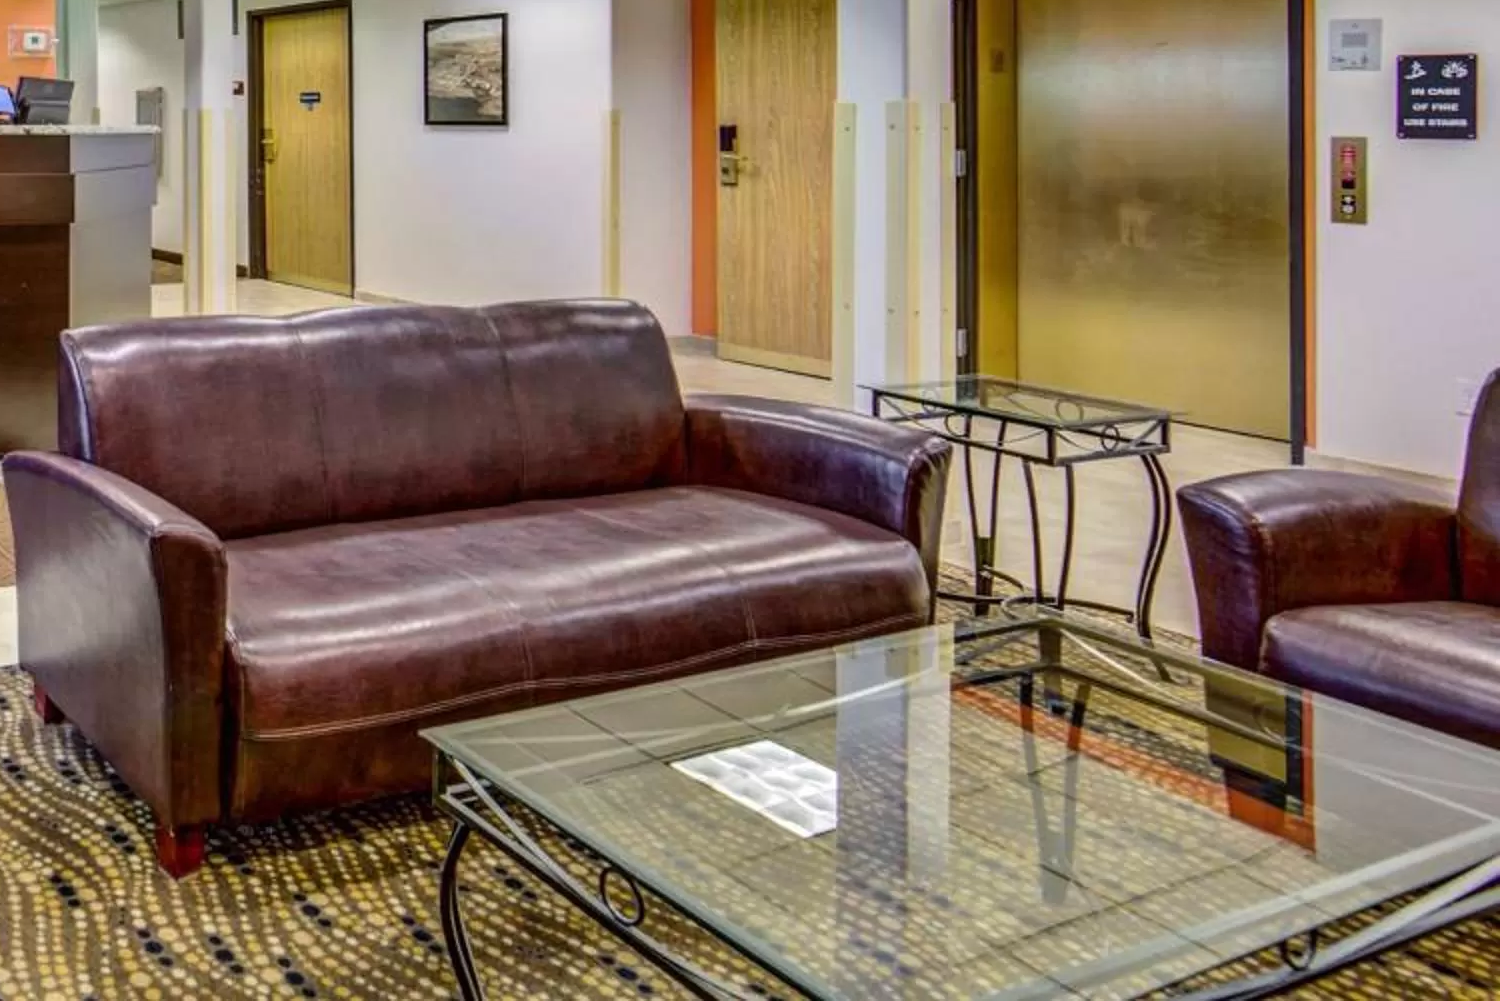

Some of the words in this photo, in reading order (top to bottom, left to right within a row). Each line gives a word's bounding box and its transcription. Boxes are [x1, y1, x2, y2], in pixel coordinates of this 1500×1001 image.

[1411, 87, 1425, 96] IN
[1427, 87, 1461, 96] CASE
[1411, 102, 1429, 112] OF
[1431, 102, 1460, 112] FIRE
